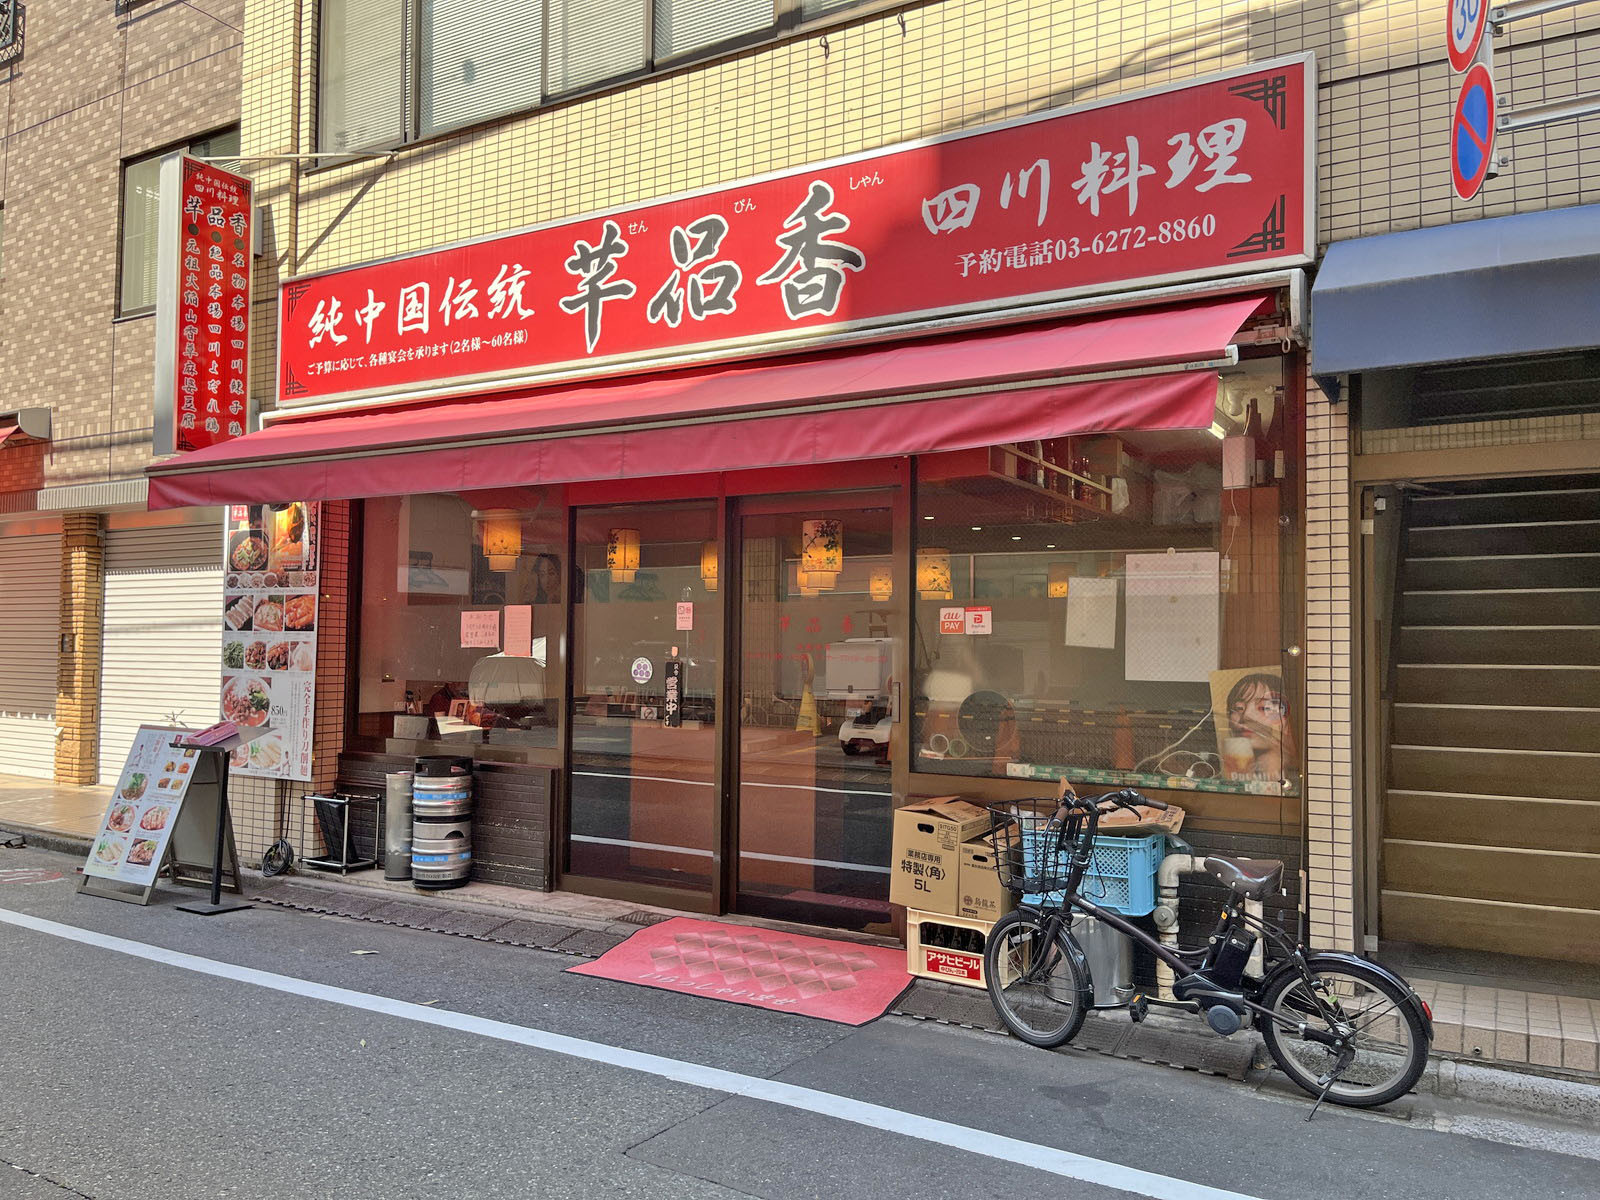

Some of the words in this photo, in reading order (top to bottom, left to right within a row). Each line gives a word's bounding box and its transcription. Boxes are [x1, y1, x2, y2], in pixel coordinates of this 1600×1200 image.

[1456, 0, 1479, 40] 30
[921, 117, 1253, 235] 四川料理
[194, 184, 240, 206] 四川料理
[628, 221, 648, 235] せん
[954, 213, 1217, 278] 予約電話03-6272-8860
[307, 263, 536, 349] 純中国伝統
[944, 622, 960, 630] PAY
[913, 878, 932, 893] 5L
[927, 951, 980, 970] アサヒビール
